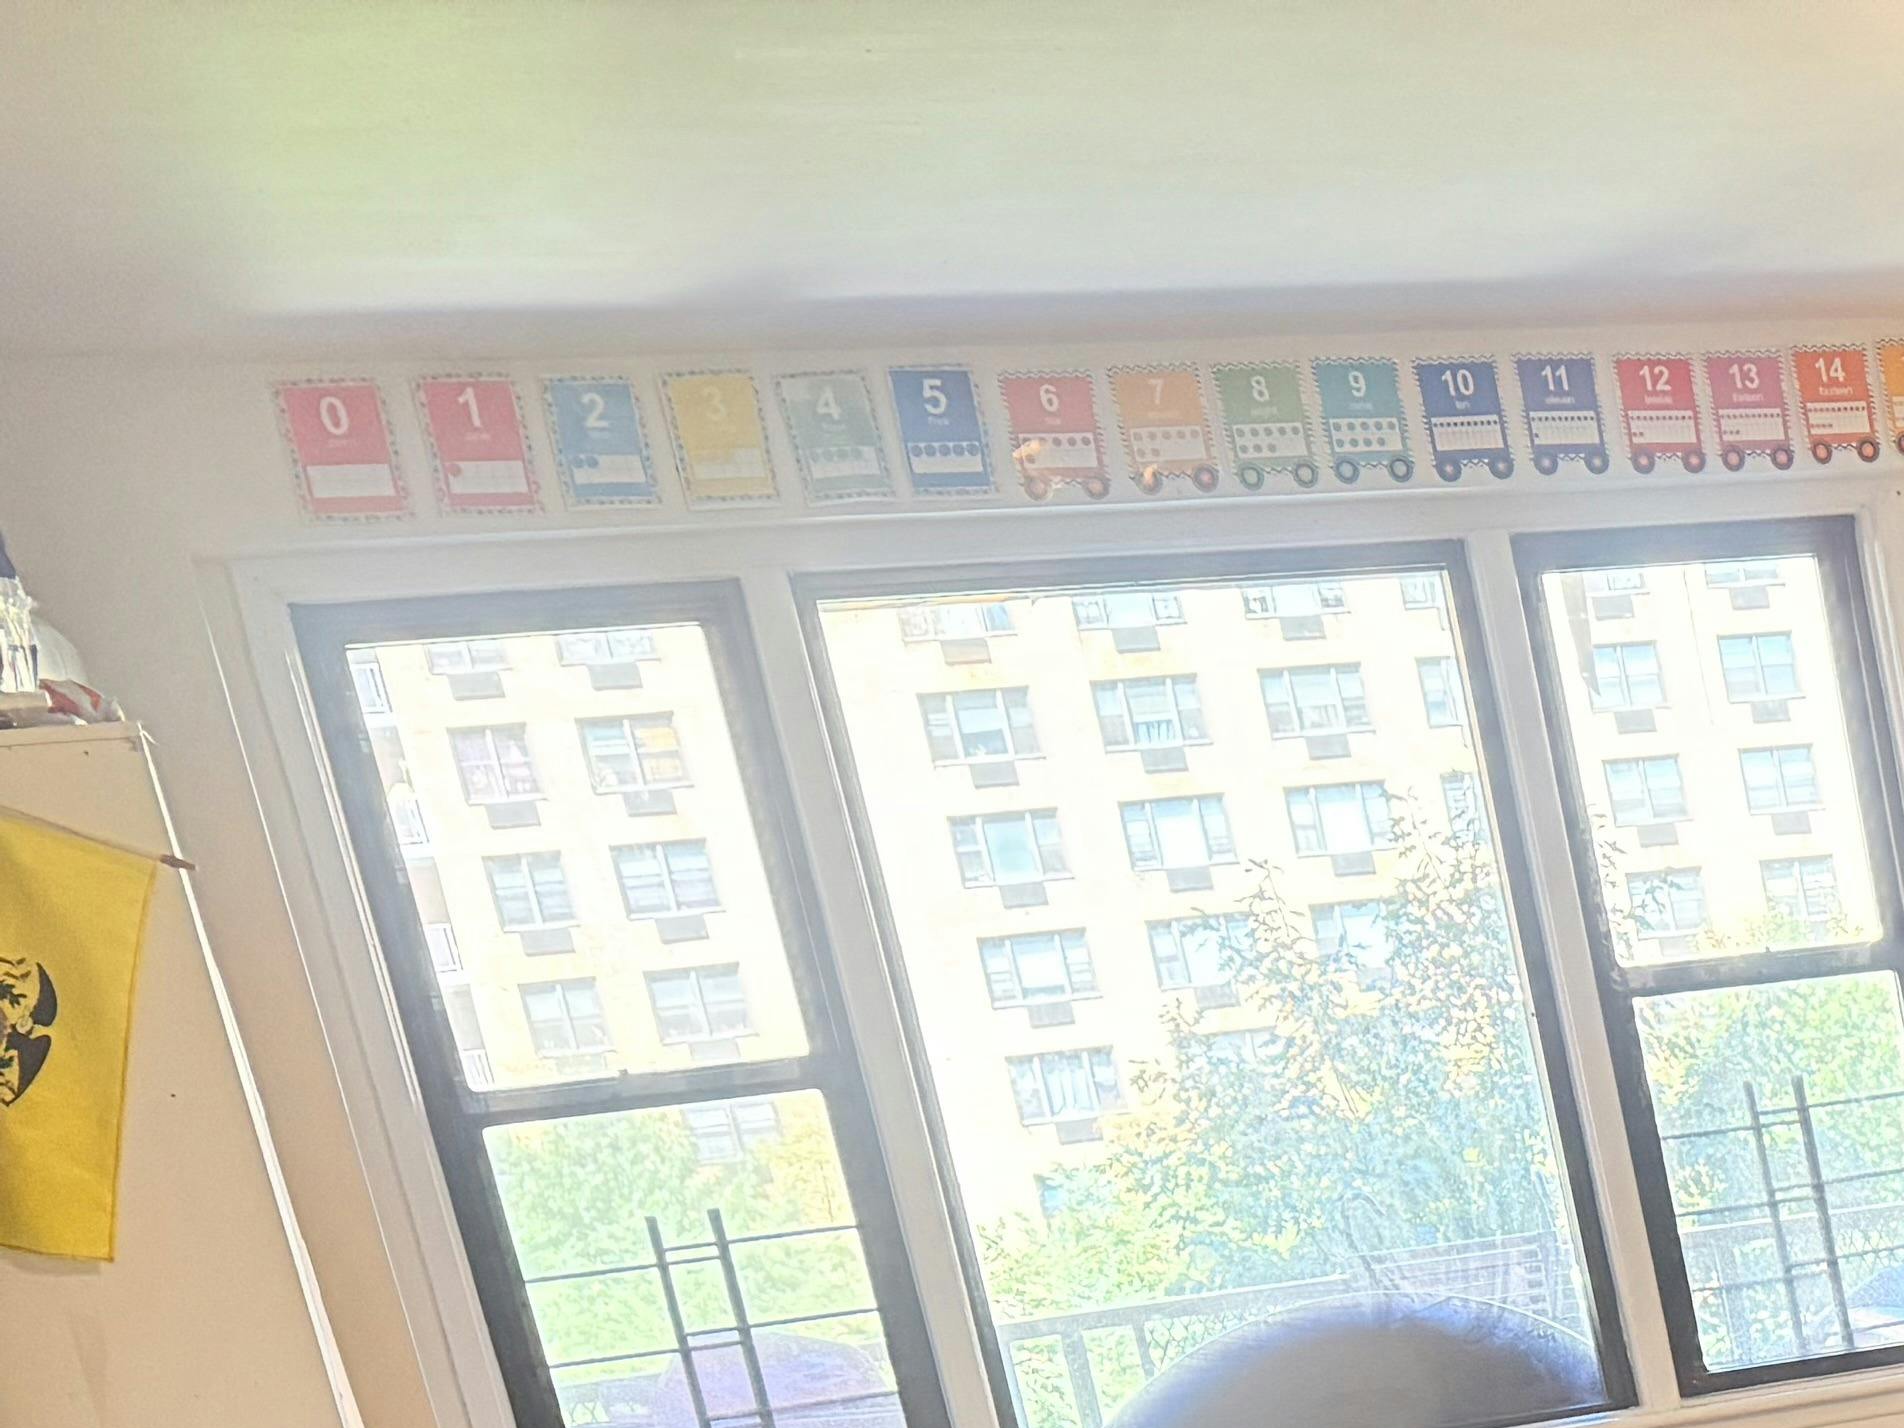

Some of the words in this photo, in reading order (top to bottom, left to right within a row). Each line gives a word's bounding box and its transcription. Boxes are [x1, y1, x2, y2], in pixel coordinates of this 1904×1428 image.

[1441, 369, 1475, 397] 10
[1541, 366, 1570, 392] 11
[1639, 366, 1672, 392] 12
[1729, 363, 1760, 390] 13
[1815, 357, 1846, 383] 14
[922, 379, 947, 415] 5
[1039, 384, 1060, 413] 6
[1147, 378, 1164, 405] 7
[1252, 376, 1270, 402] 8
[1348, 371, 1367, 398] 9
[319, 396, 349, 436] 0
[458, 387, 482, 428] 1
[581, 393, 609, 428] 2
[703, 385, 728, 420] 3
[816, 385, 841, 420] 4
